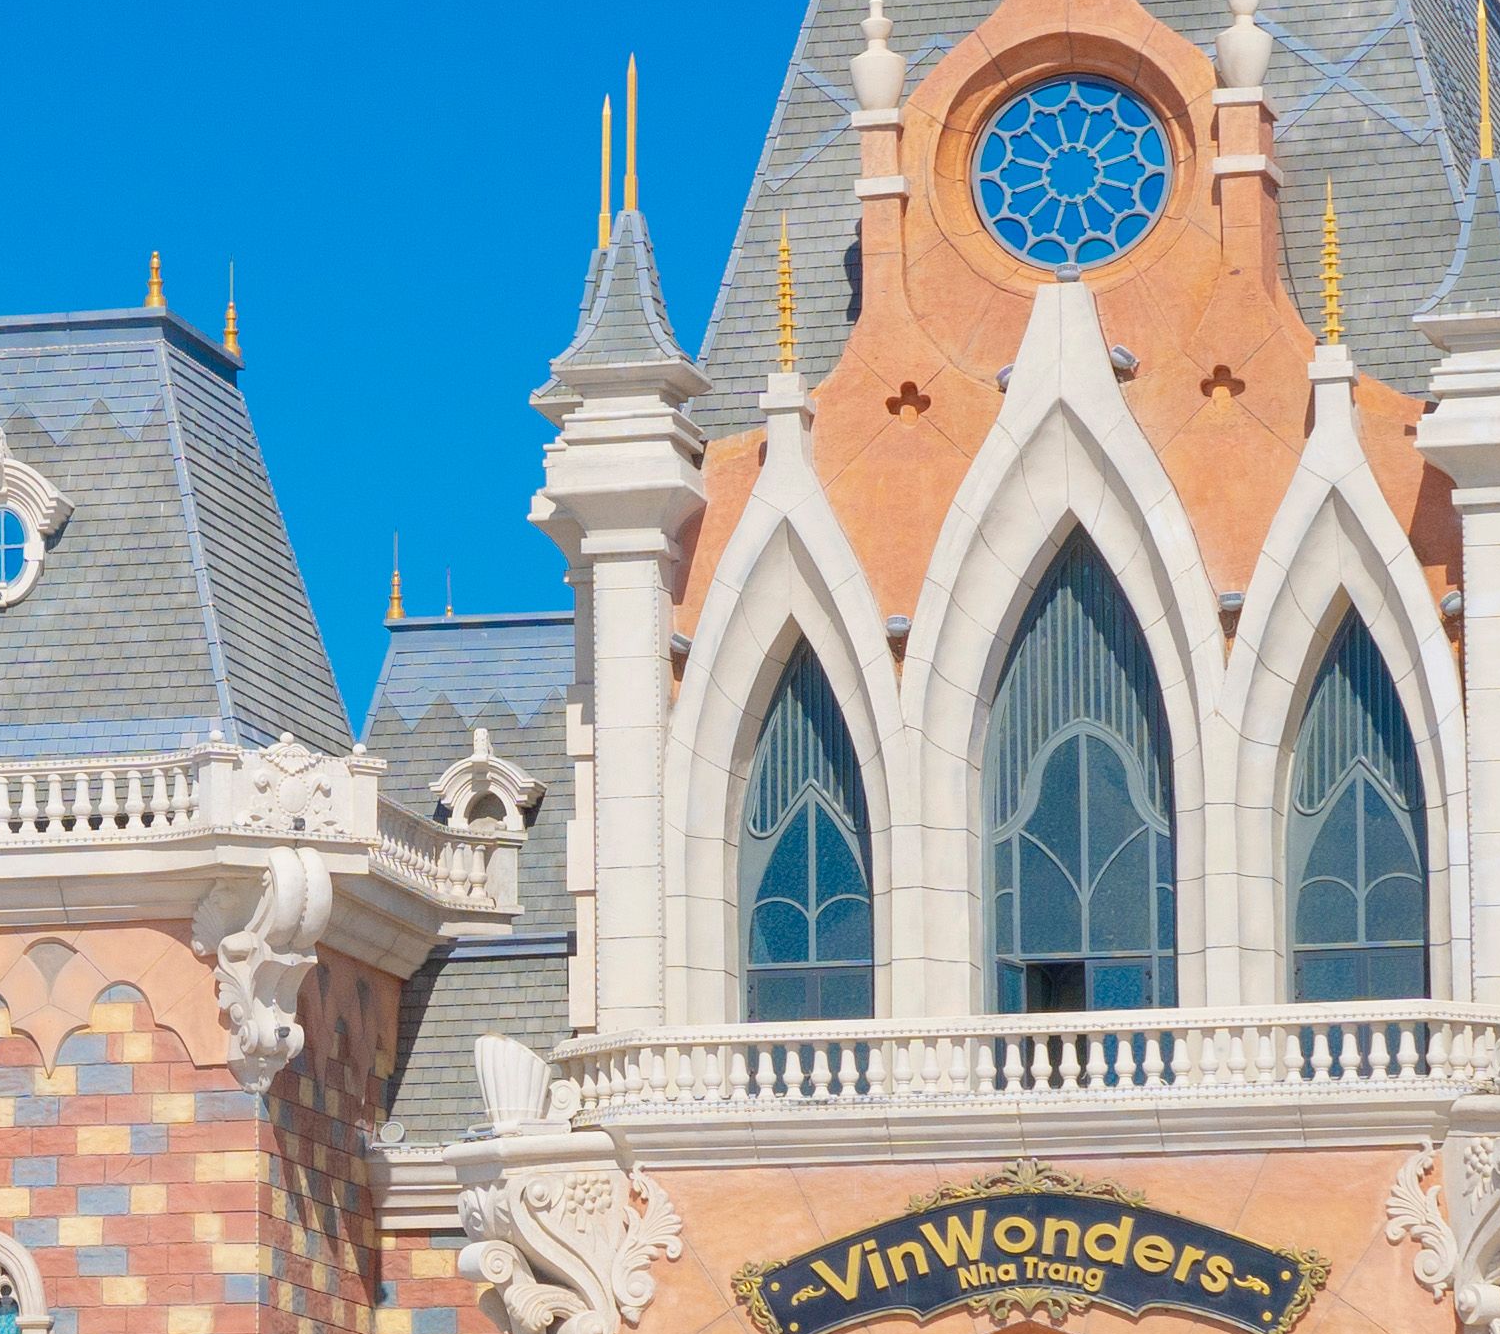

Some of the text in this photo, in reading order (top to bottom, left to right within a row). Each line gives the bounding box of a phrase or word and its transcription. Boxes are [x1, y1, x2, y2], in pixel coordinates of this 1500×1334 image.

[810, 1209, 1236, 1302] VinWonders
[957, 1255, 1105, 1293] Nha Trang
